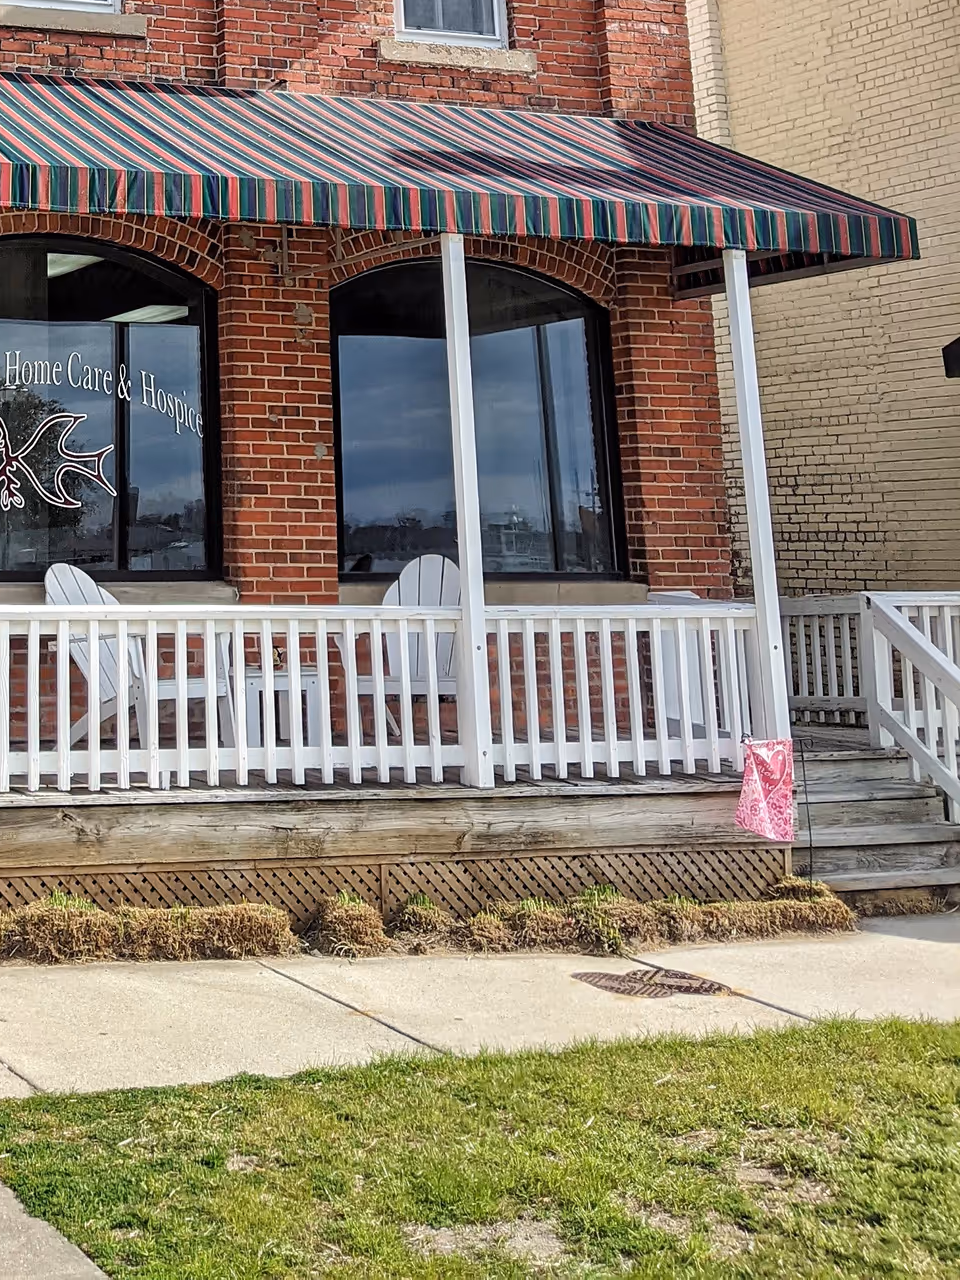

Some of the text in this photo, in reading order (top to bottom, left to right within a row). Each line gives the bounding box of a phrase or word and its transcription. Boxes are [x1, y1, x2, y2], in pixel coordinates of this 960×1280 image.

[4, 350, 62, 387] Home
[67, 351, 113, 395] Care
[117, 363, 132, 402] &
[139, 370, 204, 438] Hospice
